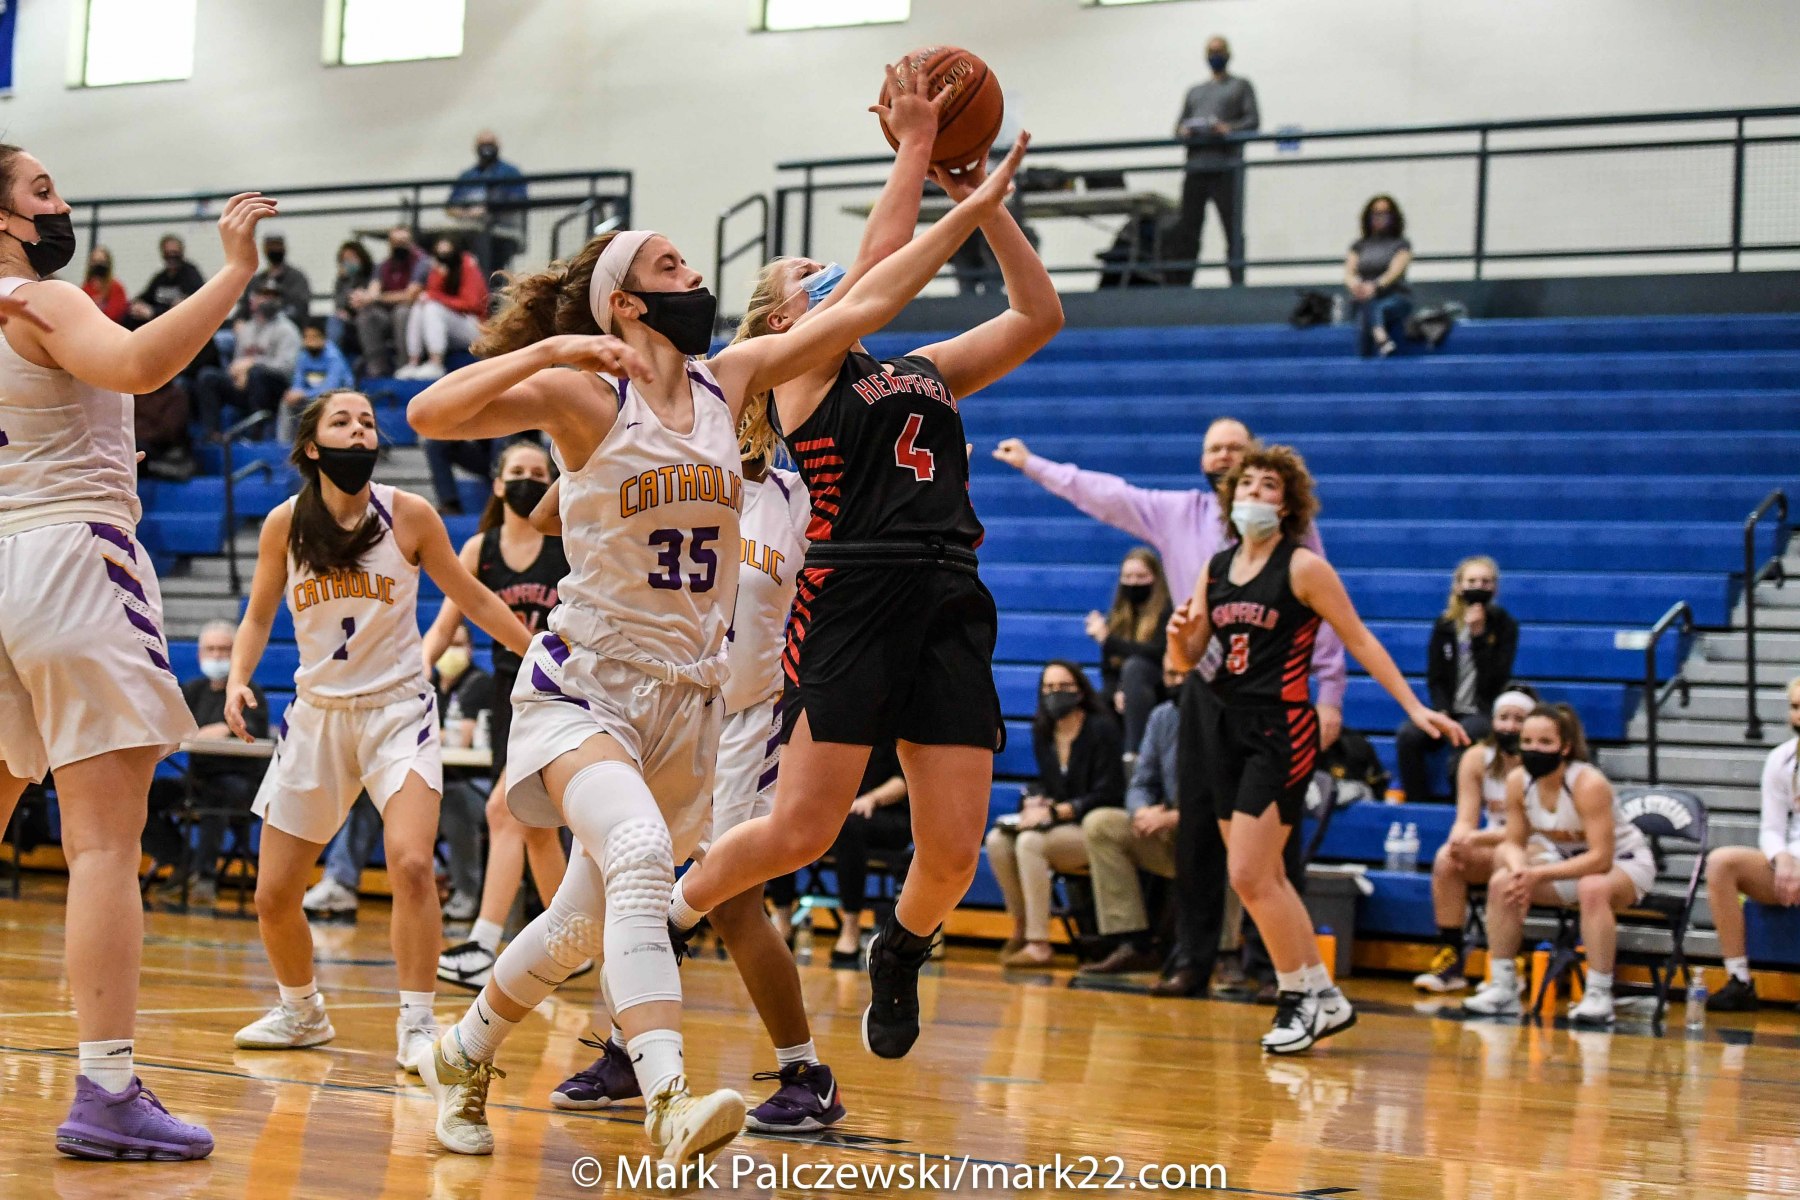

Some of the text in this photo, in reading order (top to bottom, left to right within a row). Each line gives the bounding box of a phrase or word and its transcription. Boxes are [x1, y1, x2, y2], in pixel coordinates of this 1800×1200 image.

[894, 412, 936, 482] 4
[648, 526, 720, 593] 35
[294, 571, 396, 612] CATHOLIC
[331, 616, 356, 661] 1
